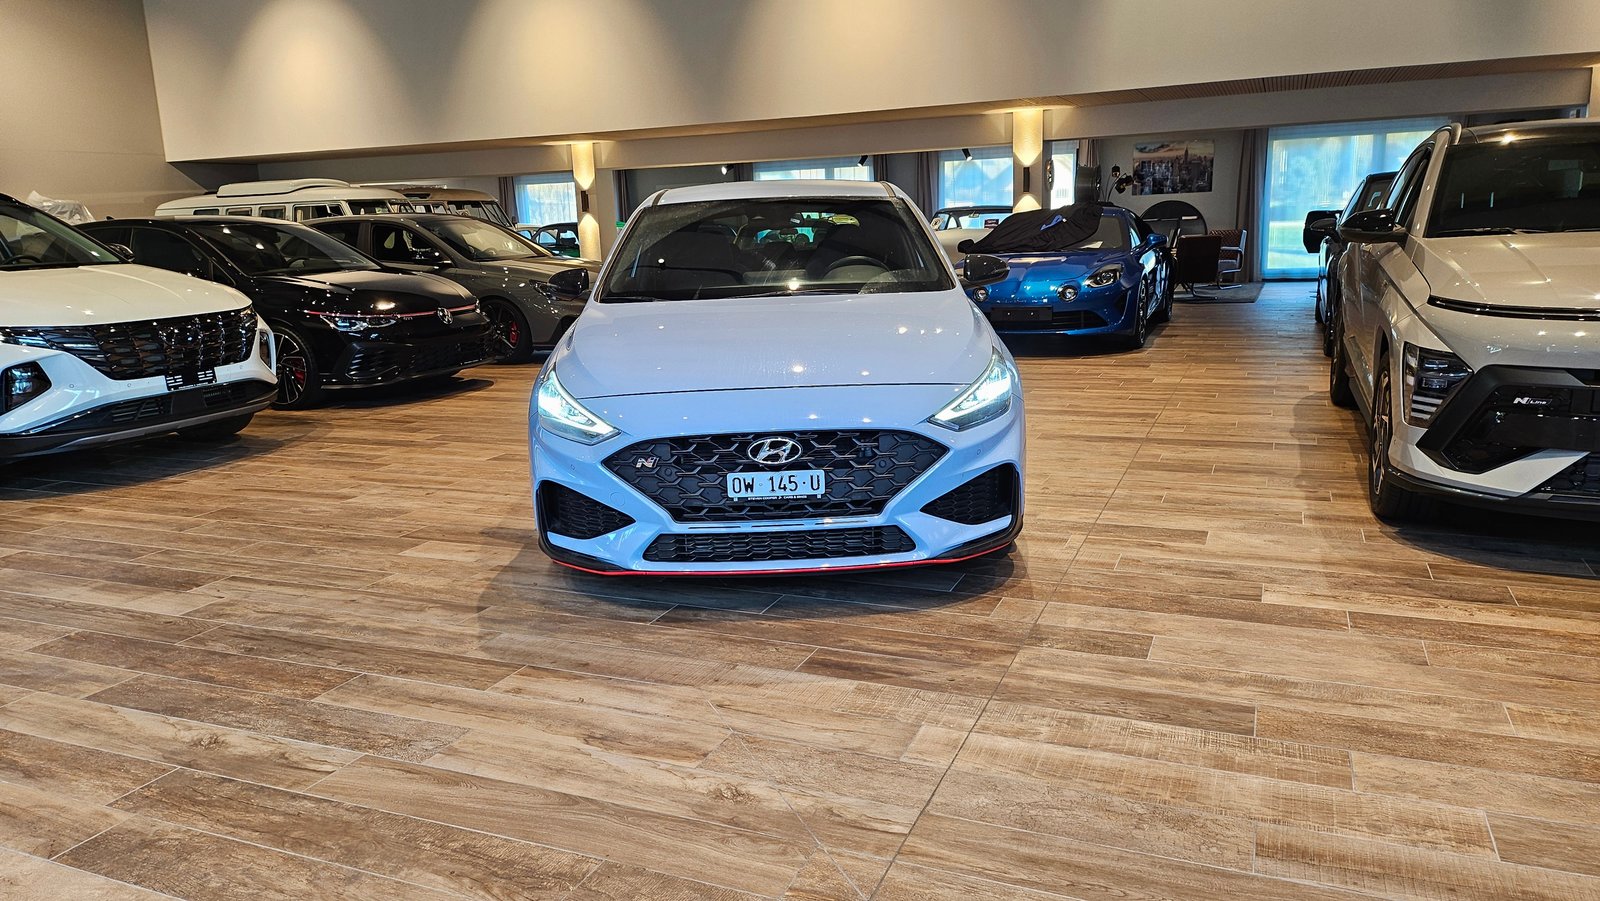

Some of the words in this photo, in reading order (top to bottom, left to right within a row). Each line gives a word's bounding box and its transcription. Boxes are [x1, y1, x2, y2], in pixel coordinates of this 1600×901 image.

[732, 476, 755, 494] OW
[768, 474, 799, 493] 145
[810, 474, 821, 491] U
